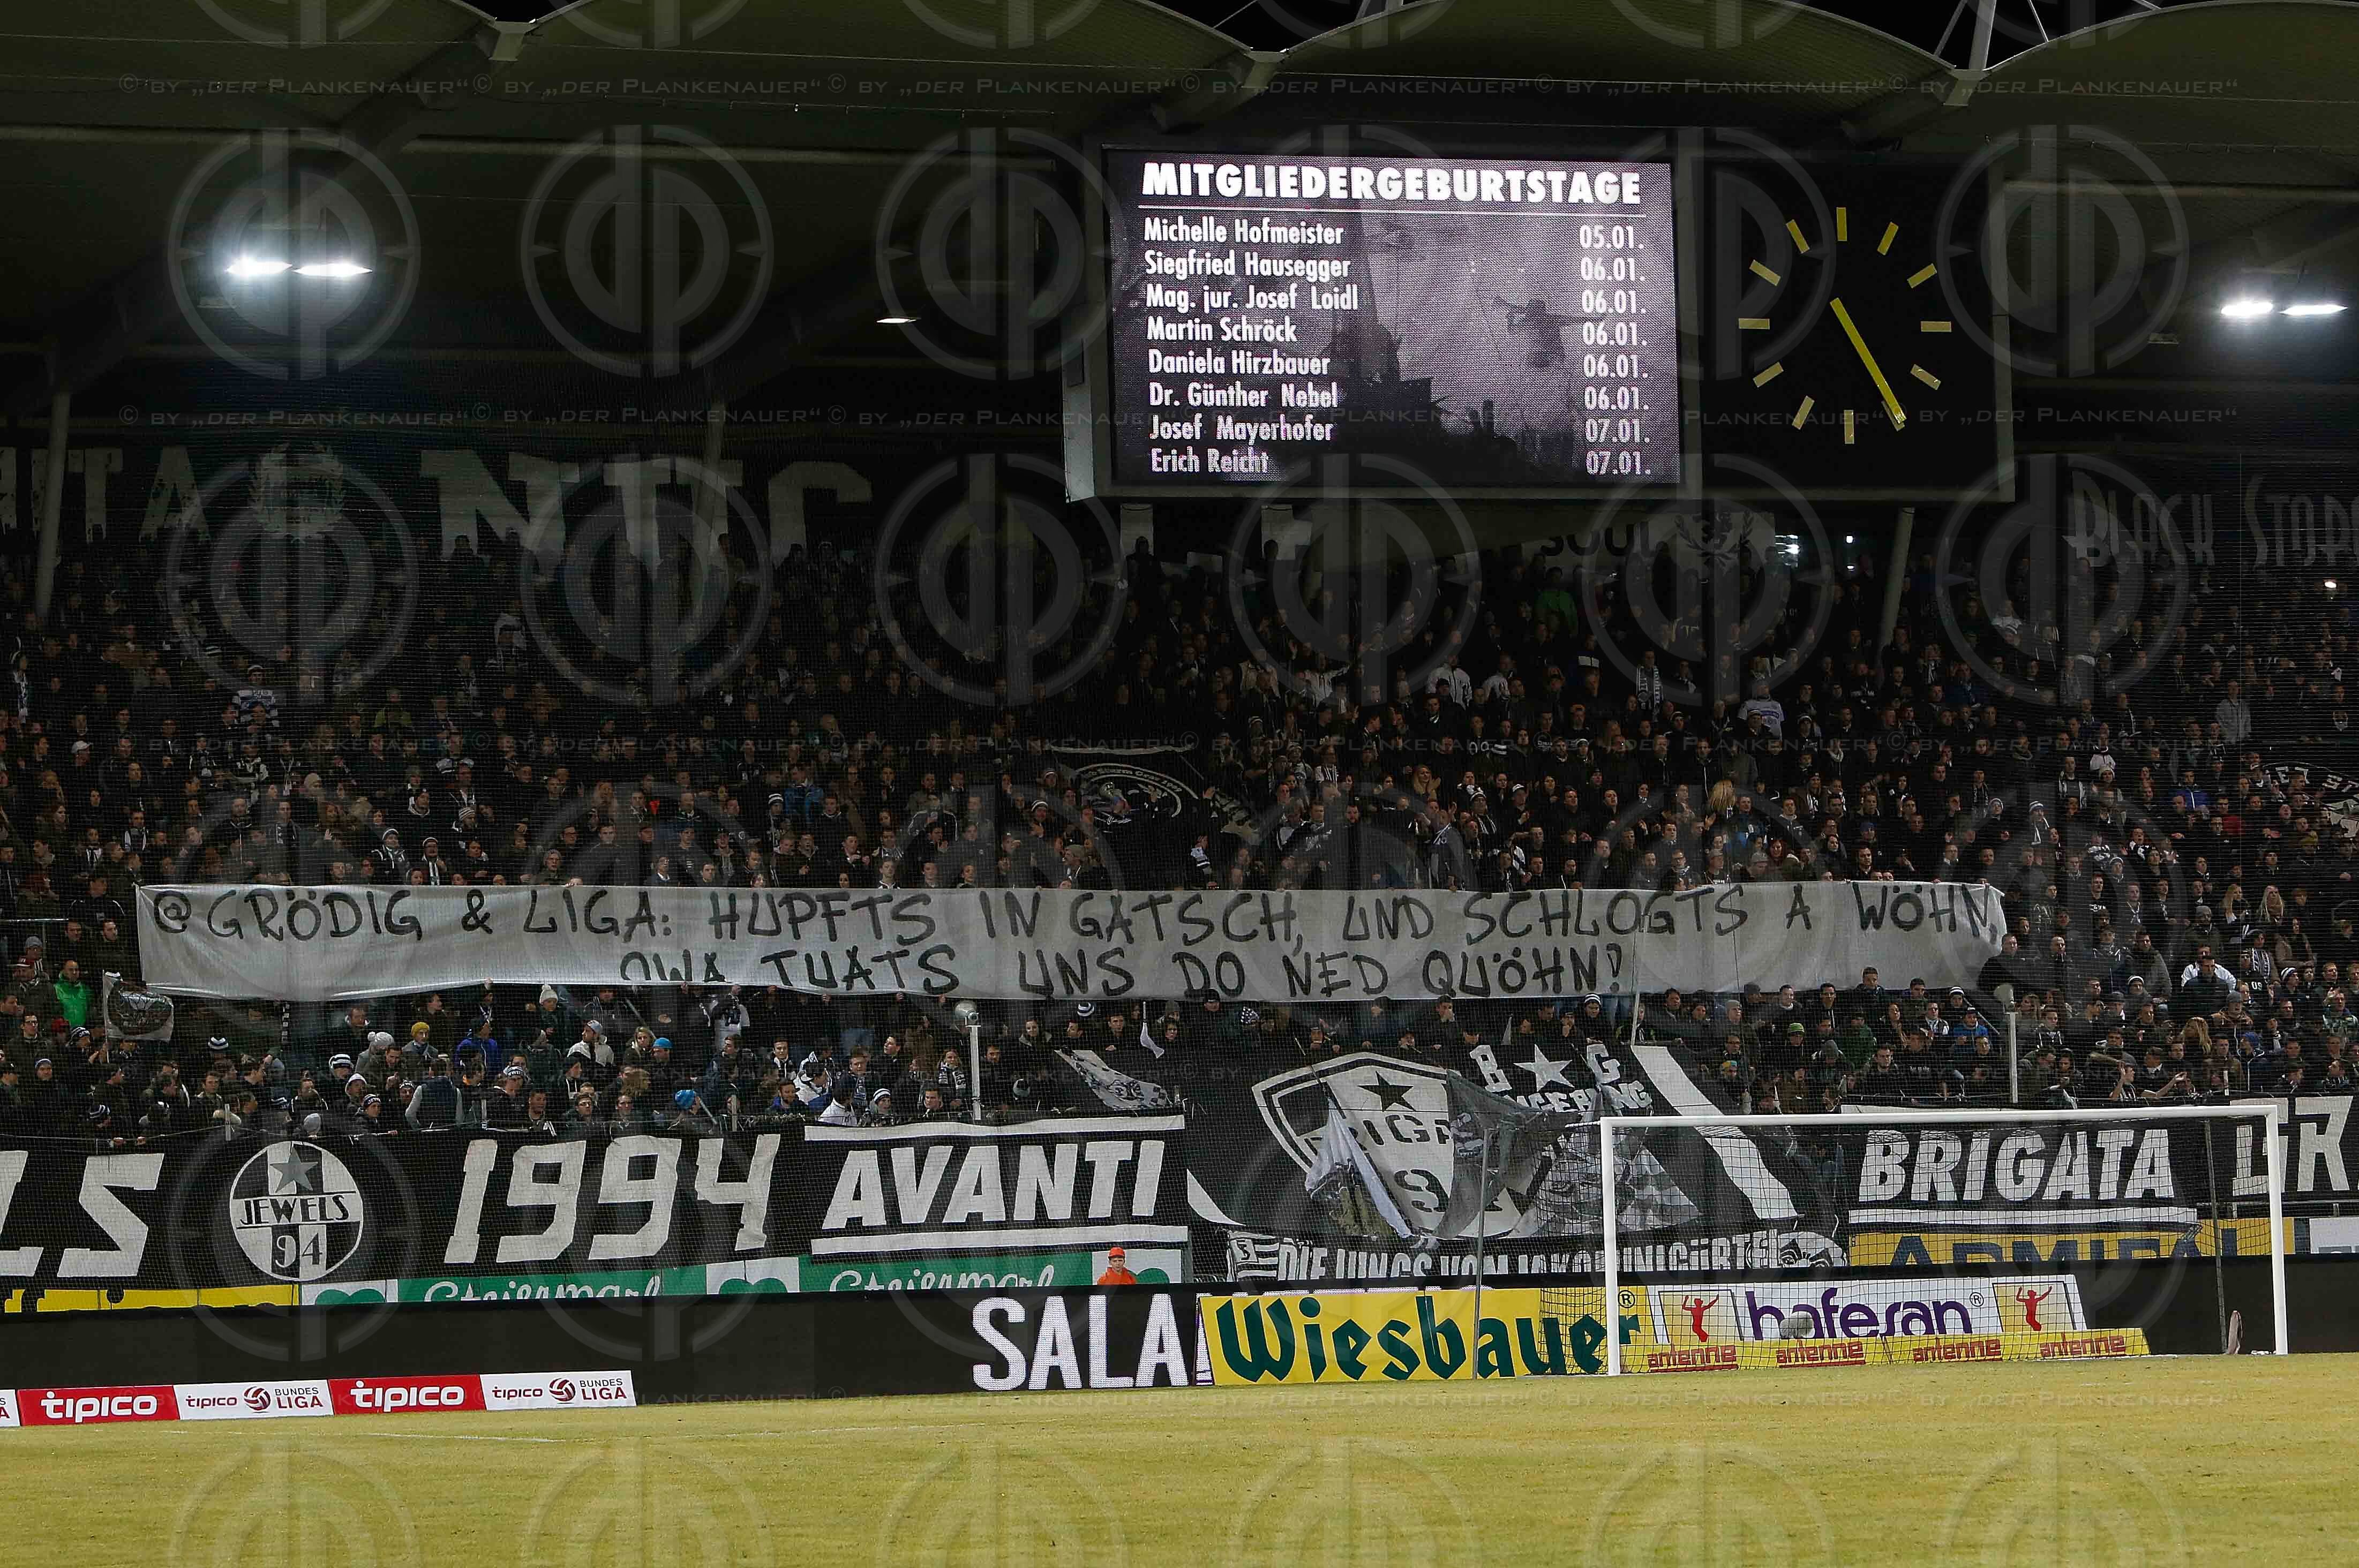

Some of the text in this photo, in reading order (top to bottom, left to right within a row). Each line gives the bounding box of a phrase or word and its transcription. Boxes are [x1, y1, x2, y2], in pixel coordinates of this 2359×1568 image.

[1144, 164, 1640, 203] MITGLIEDERGEBURTSTAGE
[1145, 216, 1343, 244] Michelle Hofmeister
[1580, 225, 1643, 248] 05.01.
[1145, 250, 1350, 283] Siegfried Hausegger
[1581, 257, 1644, 280] 06.01.
[1147, 283, 1357, 313] Mag. jur. Josef Loidl
[1582, 289, 1645, 313] 06.01.
[1148, 316, 1296, 341] Martin Schröck
[1583, 322, 1646, 345] 06.01.
[1150, 349, 1329, 374] Daniela Hirzbauer
[1583, 353, 1647, 378] 06.01.
[1150, 382, 1336, 406] Dr. Günther Nebel
[1584, 386, 1648, 410] 06.01.
[1151, 413, 1332, 445] Josef Mayerhofer
[1586, 418, 1649, 442] 07.01.
[1152, 447, 1199, 471] Erich
[1587, 451, 1650, 474] 07.01.
[461, 889, 493, 934] &
[523, 889, 672, 943] LIGA:
[708, 890, 936, 946] HUPFTS
[979, 891, 1042, 938] IN
[1069, 892, 1304, 956] GATSCH,
[1342, 893, 1434, 943] UND
[1463, 886, 1748, 946] SCHLOGTS
[1786, 883, 1813, 931] A
[761, 945, 959, 994] TUATS
[1019, 948, 1135, 999] UNS
[1171, 951, 1245, 997] DO
[1282, 951, 1388, 997] NED
[1859, 1129, 2175, 1203] BRIGATA
[822, 1140, 1165, 1230] AVANTI
[240, 1194, 351, 1225] JEWELS
[444, 1134, 781, 1264] 1994
[274, 1233, 323, 1268] 94
[972, 1293, 1213, 1391] SALA
[1216, 1295, 1641, 1383] Wiesbauer
[1776, 1339, 1865, 1363] antenne
[1912, 1337, 2002, 1362] antenne
[2039, 1332, 2126, 1357] antenne
[1647, 1339, 1737, 1367] antenne
[275, 1386, 318, 1397] BUNDES
[492, 1385, 543, 1400] tipico
[580, 1378, 622, 1389] BUNDES
[581, 1386, 627, 1401] LIGA
[41, 1391, 157, 1422] tipico
[186, 1394, 237, 1408] tipico
[276, 1395, 324, 1409] LIGA
[350, 1381, 464, 1412] tipico
